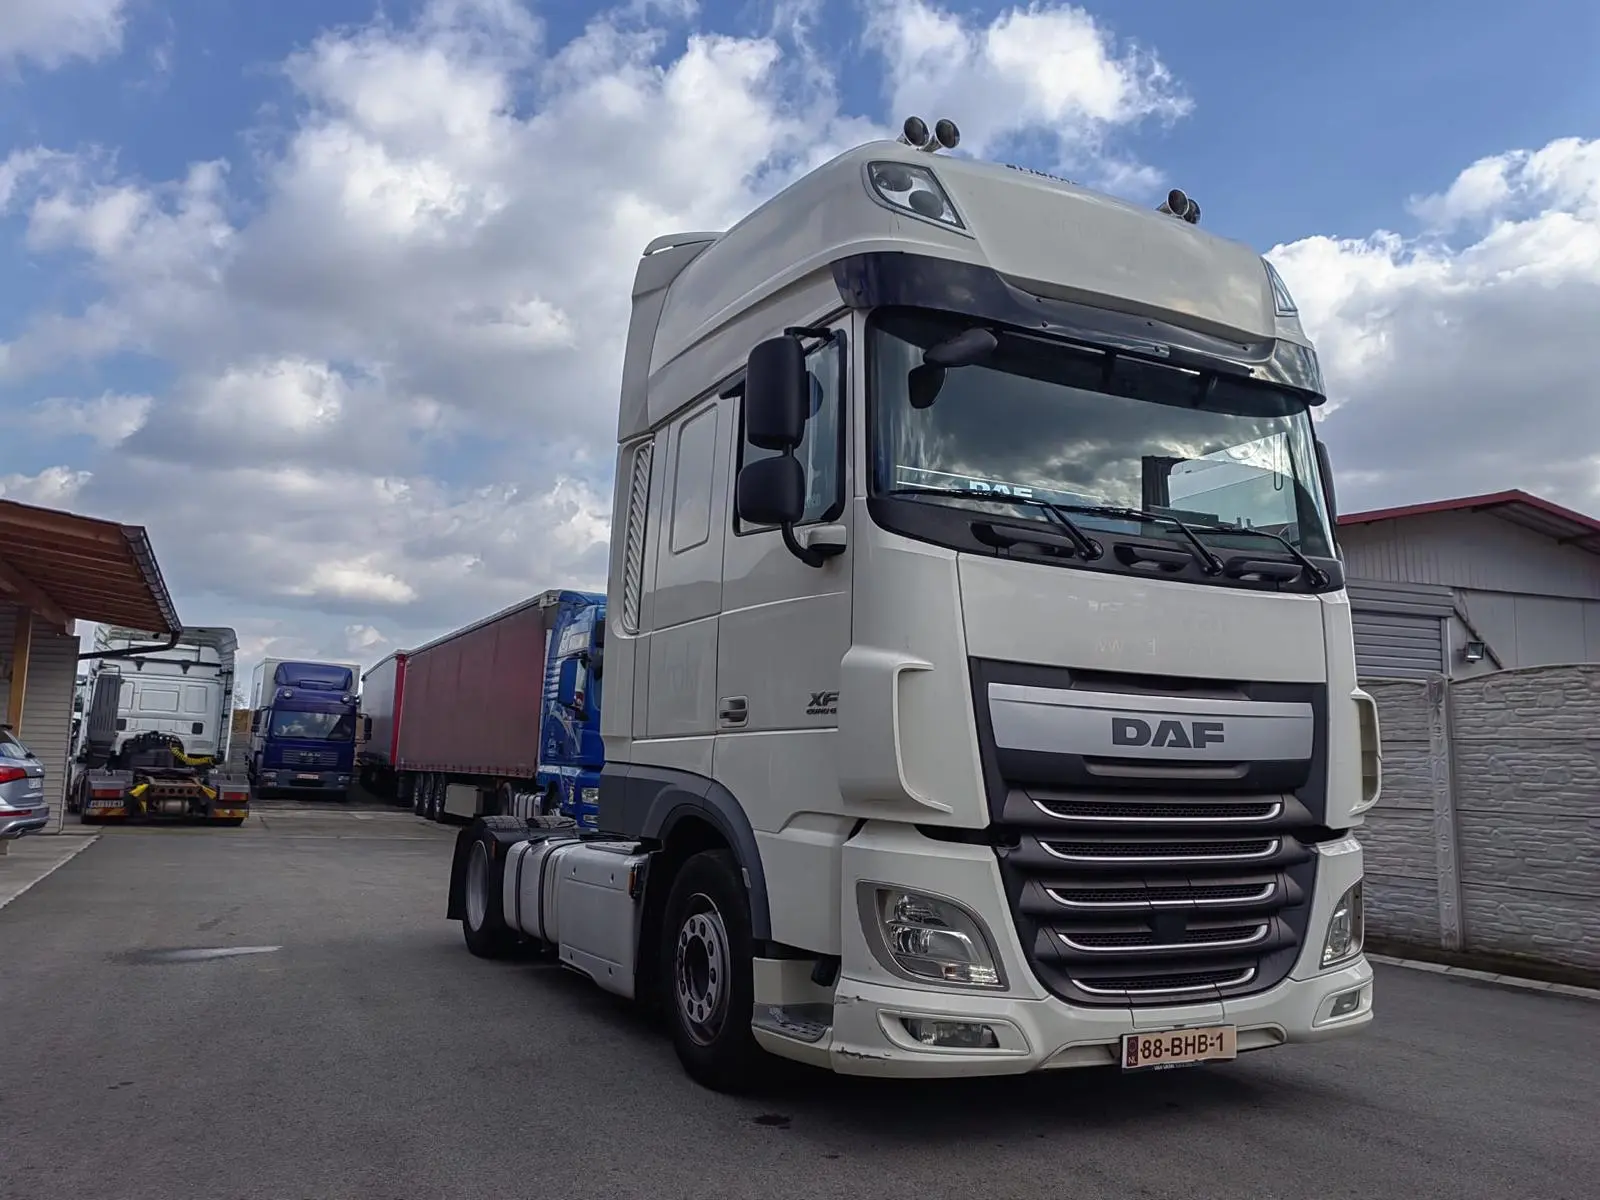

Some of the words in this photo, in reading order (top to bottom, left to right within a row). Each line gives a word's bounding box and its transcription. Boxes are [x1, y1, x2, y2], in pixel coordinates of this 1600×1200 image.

[808, 691, 840, 706] XF
[1112, 717, 1225, 748] DAF
[1141, 1032, 1224, 1059] 88-BHB-1
[1128, 1057, 1138, 1065] NL
